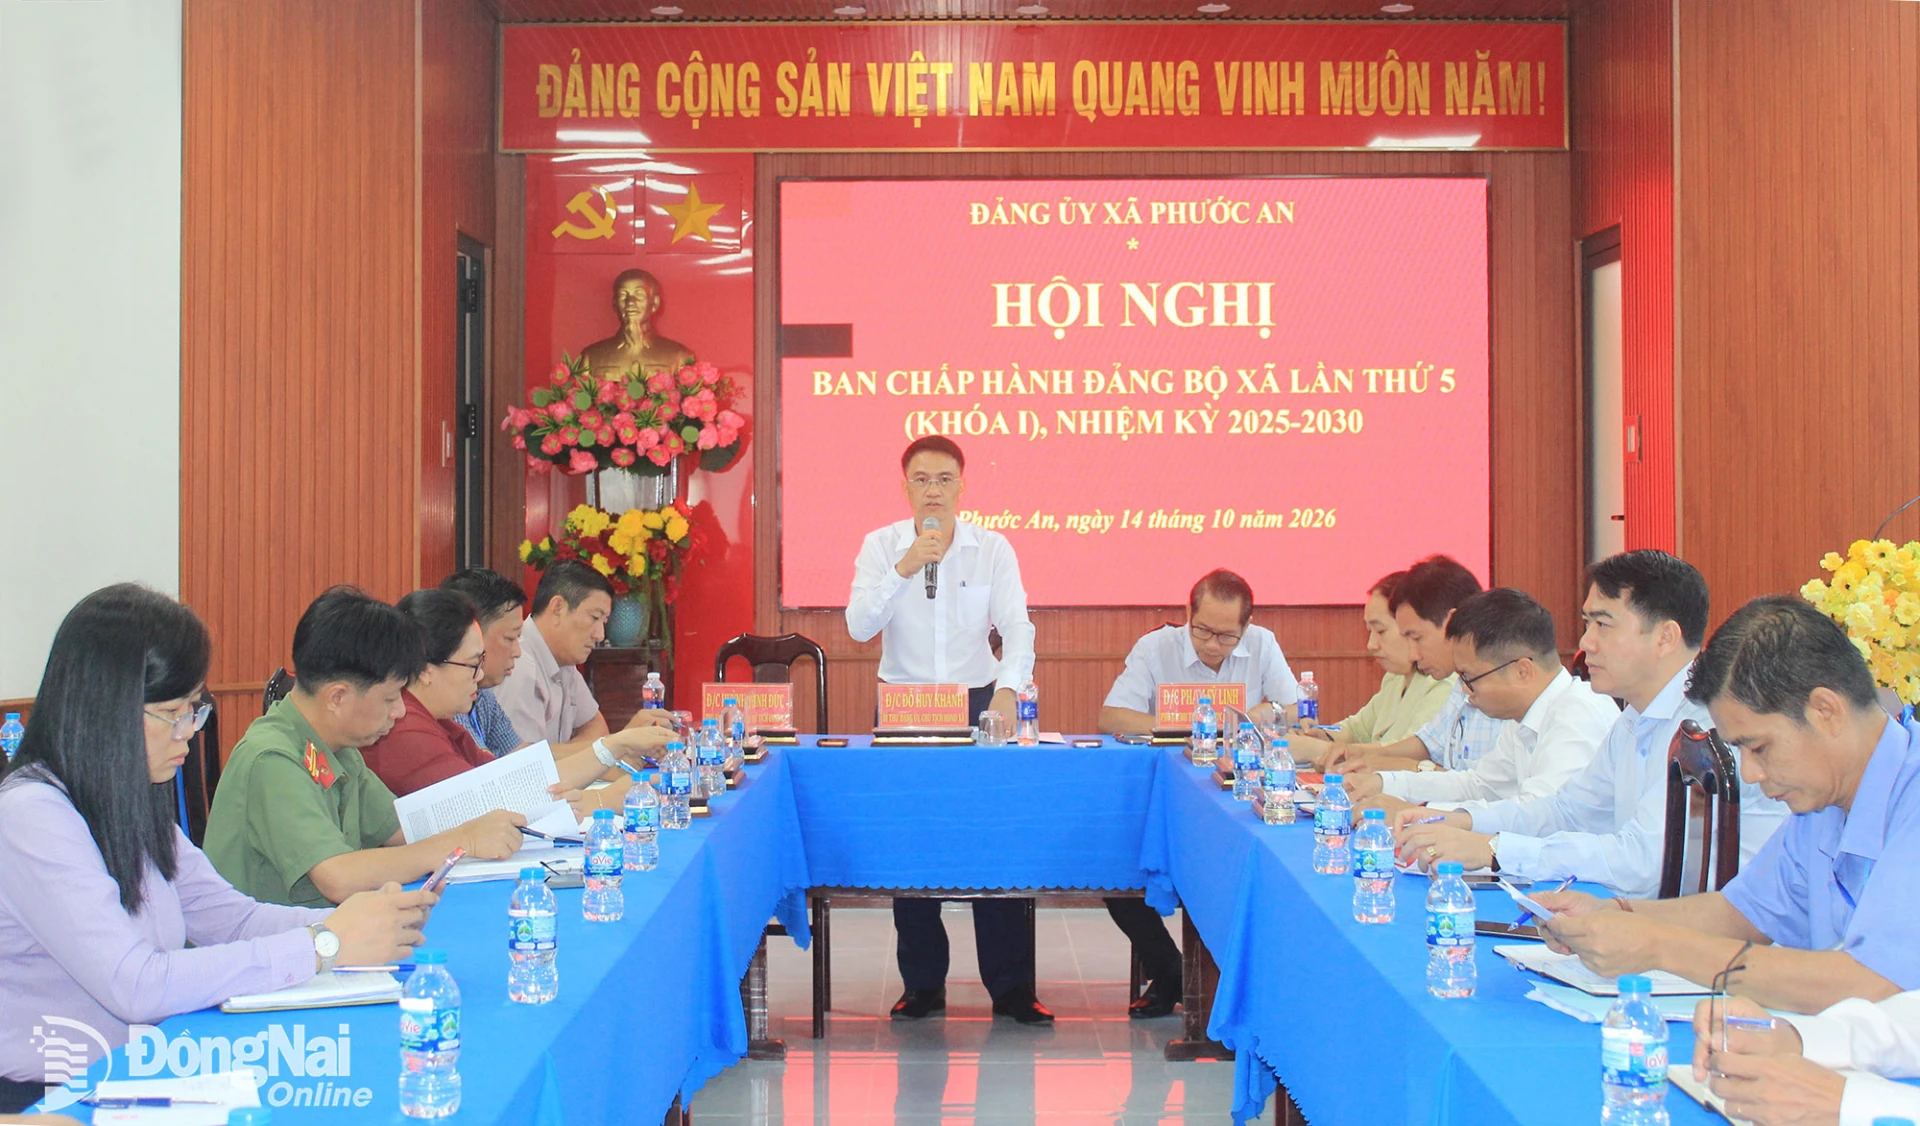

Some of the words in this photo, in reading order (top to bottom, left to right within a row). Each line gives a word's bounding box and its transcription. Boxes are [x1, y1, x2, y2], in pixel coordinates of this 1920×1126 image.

[536, 48, 640, 118] ĐẢNG
[657, 51, 760, 129] CỘNG
[776, 48, 850, 117] SẢN
[867, 50, 954, 128] VIỆT
[969, 62, 1055, 116] NAM
[1073, 60, 1199, 122] QUANG
[1215, 62, 1304, 116] VINH
[1320, 49, 1430, 117] MUÔN
[1445, 50, 1546, 116] NĂM!
[970, 197, 1050, 225] ĐẢNG
[1059, 197, 1096, 225] ỦY
[1104, 197, 1142, 225] XÃ
[1151, 196, 1249, 225] PHƯỚC
[1257, 201, 1295, 224] AN
[991, 275, 1104, 340] HỘI
[1120, 282, 1277, 340] NGHỊ
[813, 370, 877, 396] BAN
[886, 361, 974, 396] CHẤP
[982, 362, 1074, 395] HÀNH
[1083, 362, 1174, 395] ĐẢNG
[1183, 365, 1228, 400] BỘ
[1237, 362, 1281, 394] XÃ
[1291, 361, 1354, 394] LẦN
[1363, 361, 1436, 394] THỨ
[1440, 369, 1456, 393] 5
[904, 403, 1010, 442] (KHÓA
[1018, 410, 1048, 442] I),
[1056, 406, 1165, 441] NHIỆM
[1175, 402, 1220, 434] KỲ
[1229, 408, 1364, 435] 2025-2030
[1024, 509, 1060, 532] An,
[1066, 509, 1114, 534] ngày
[1120, 509, 1144, 529] 14
[1148, 508, 1205, 534] tháng
[1211, 509, 1236, 529] 10
[1240, 509, 1284, 529] năm
[1288, 508, 1336, 529] 2026
[885, 693, 901, 712] Đ/C
[916, 693, 933, 708] HUY
[1219, 688, 1239, 705] LINH
